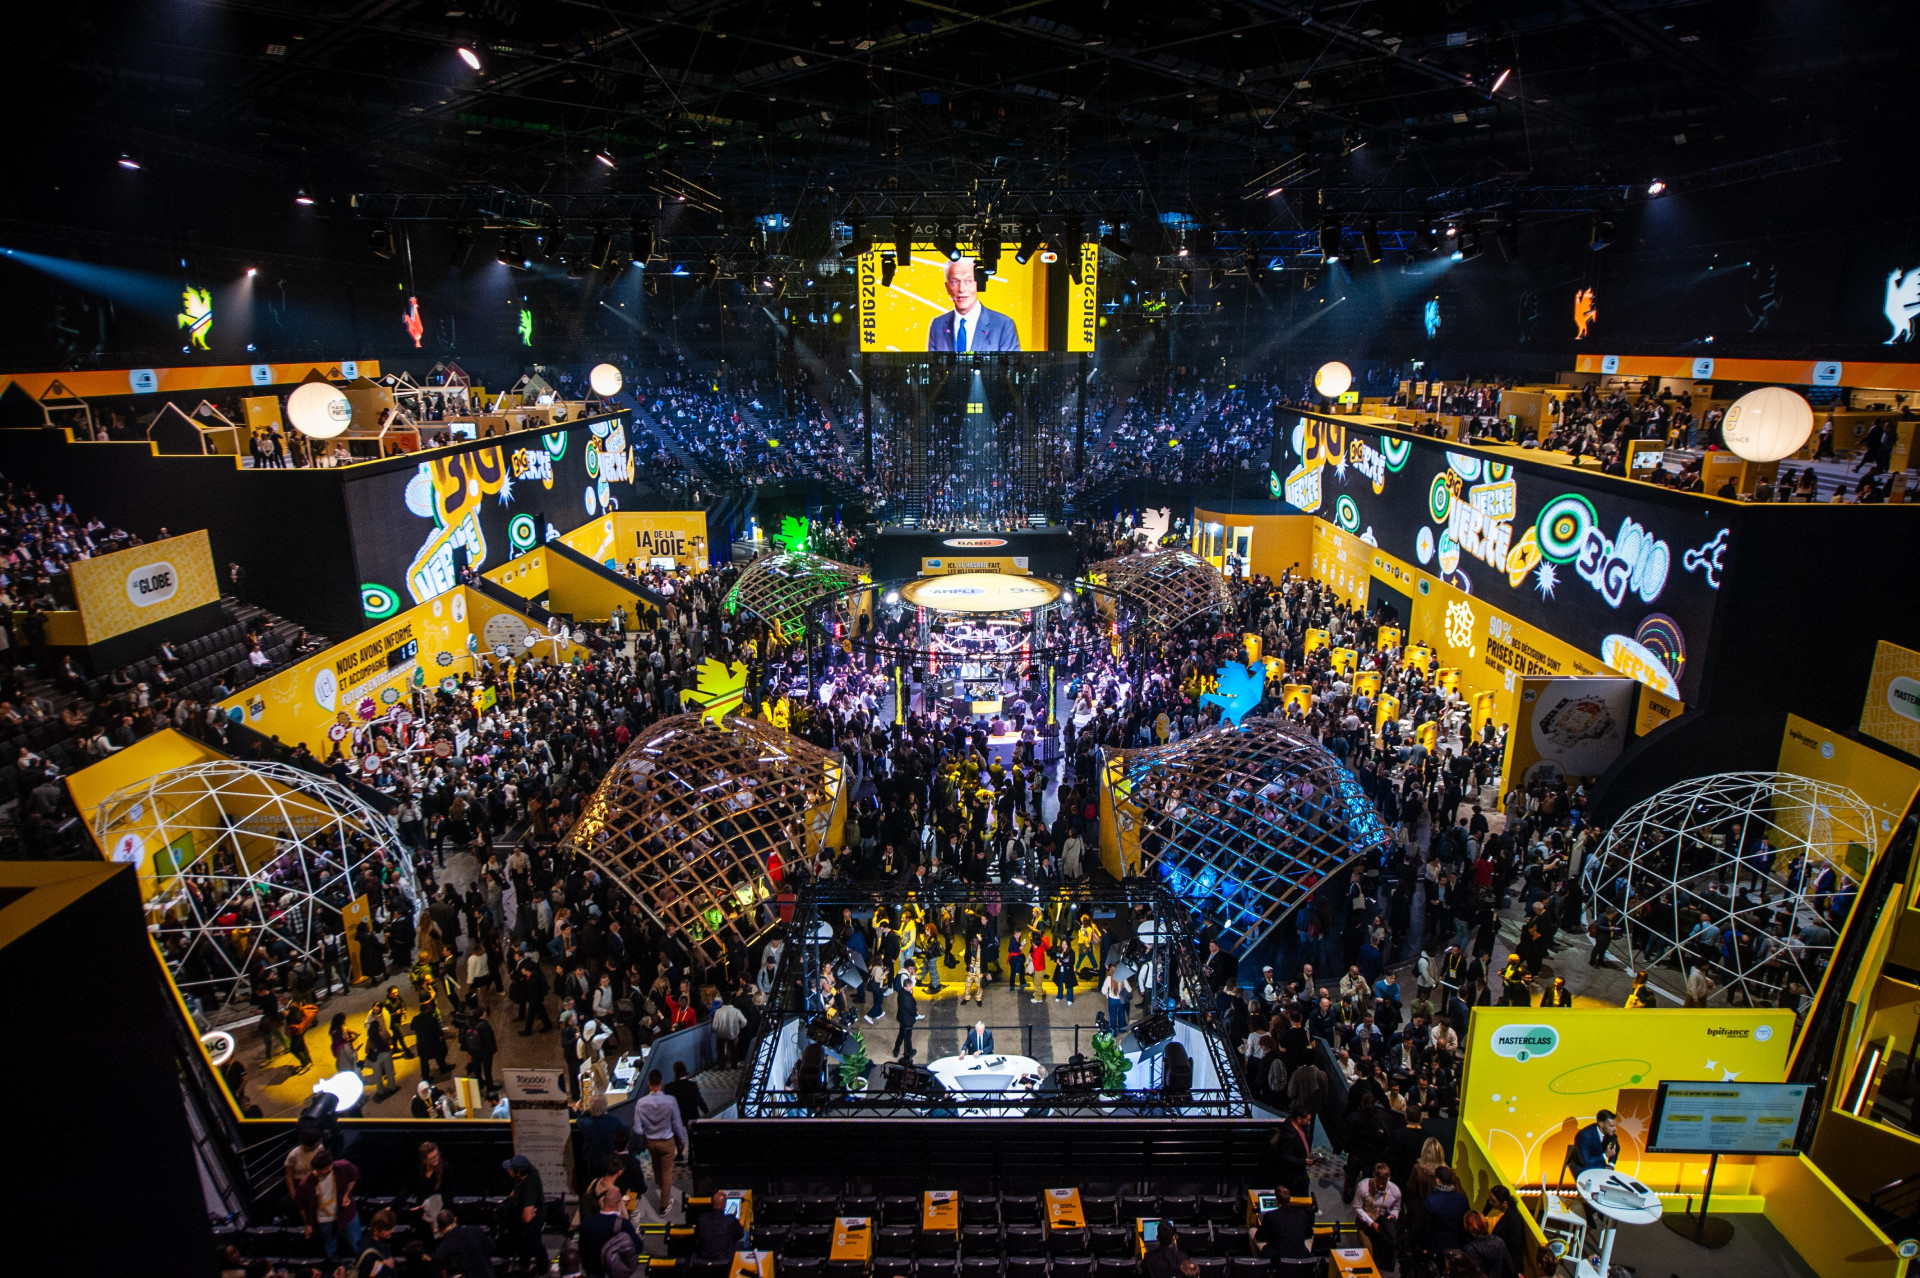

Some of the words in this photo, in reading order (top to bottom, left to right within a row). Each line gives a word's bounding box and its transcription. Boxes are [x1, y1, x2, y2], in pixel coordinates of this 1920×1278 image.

[861, 250, 877, 345] #BIG2025
[1083, 250, 1097, 344] #BIG2025
[636, 531, 652, 547] IA
[650, 540, 686, 555] JOIE
[139, 571, 172, 594] GLOBE
[336, 652, 358, 676] NOUS
[360, 639, 384, 664] AVONS
[383, 621, 413, 651] INFORMÉ
[1486, 637, 1514, 667] PRISES
[1514, 653, 1527, 674] EN
[1521, 643, 1547, 665] DÉCISIONS
[1547, 657, 1561, 673] SONT
[339, 677, 347, 692] ET
[349, 654, 387, 687] ACCOMPAGNÉ
[1649, 700, 1671, 718] ENTRÉE
[1498, 1036, 1552, 1046] MASTERCLASS
[1706, 1026, 1750, 1037] bpifrance
[1519, 1051, 1525, 1061] 1
